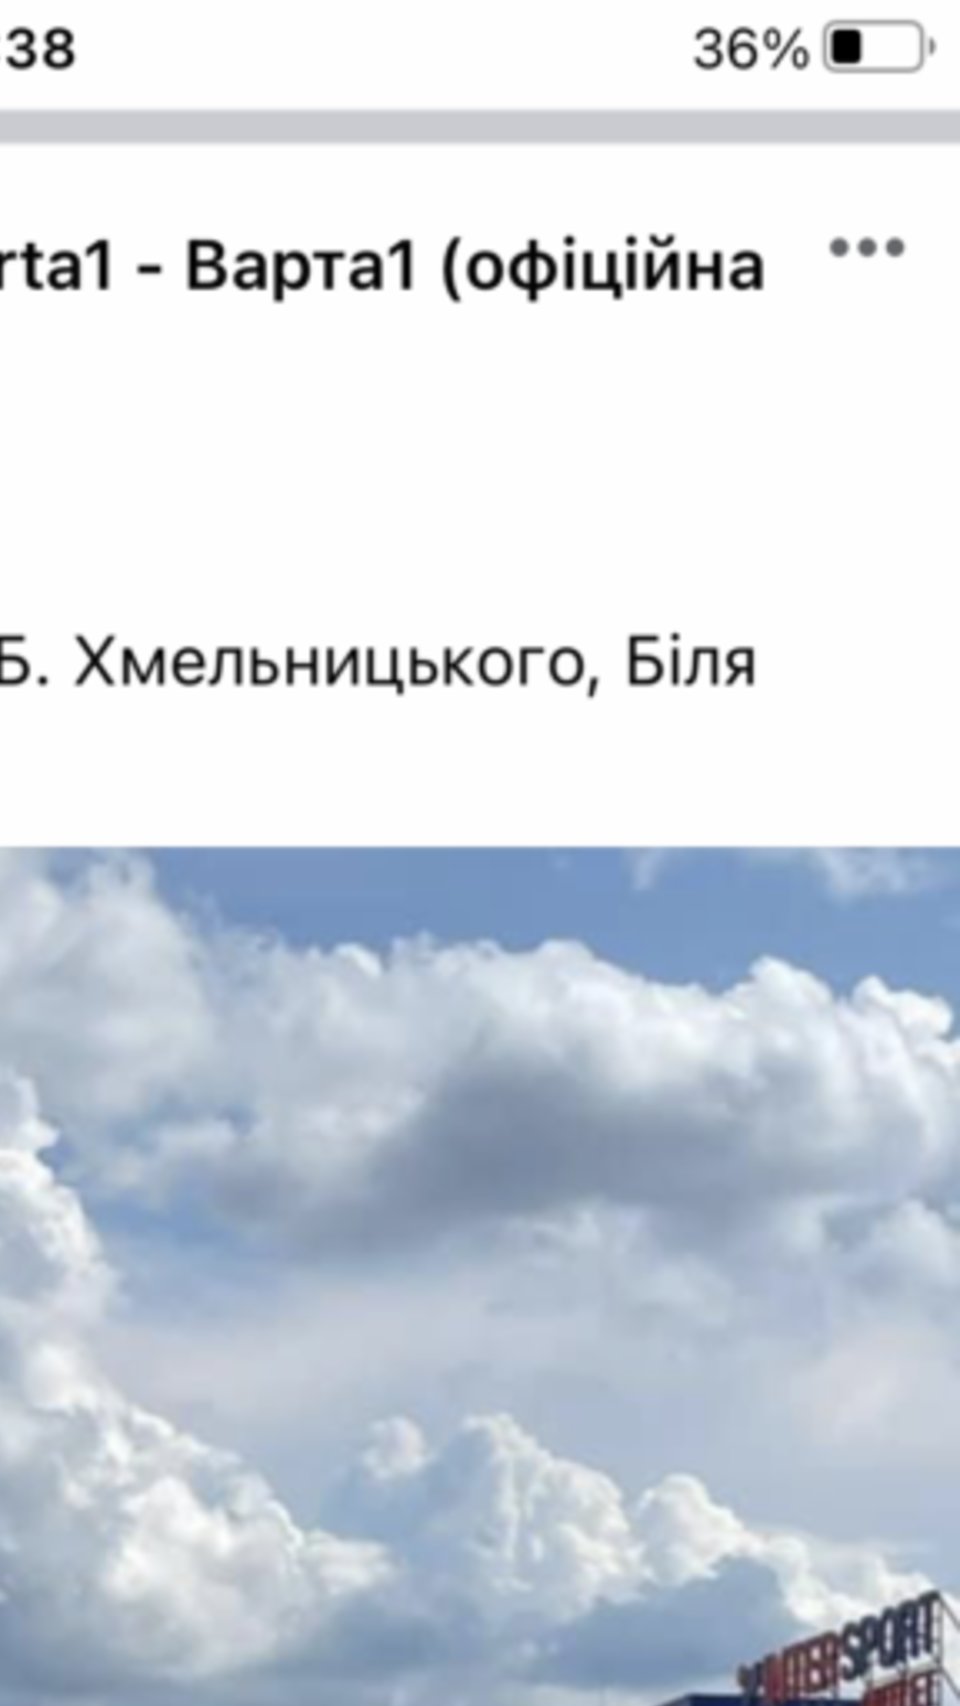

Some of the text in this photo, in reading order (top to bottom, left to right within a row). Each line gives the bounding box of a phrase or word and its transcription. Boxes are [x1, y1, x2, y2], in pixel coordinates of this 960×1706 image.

[693, 26, 811, 71] 36%
[186, 238, 413, 304] Варта1
[442, 233, 764, 304] (офіційна
[74, 634, 599, 699] Хмельницького,
[628, 631, 755, 687] Біля
